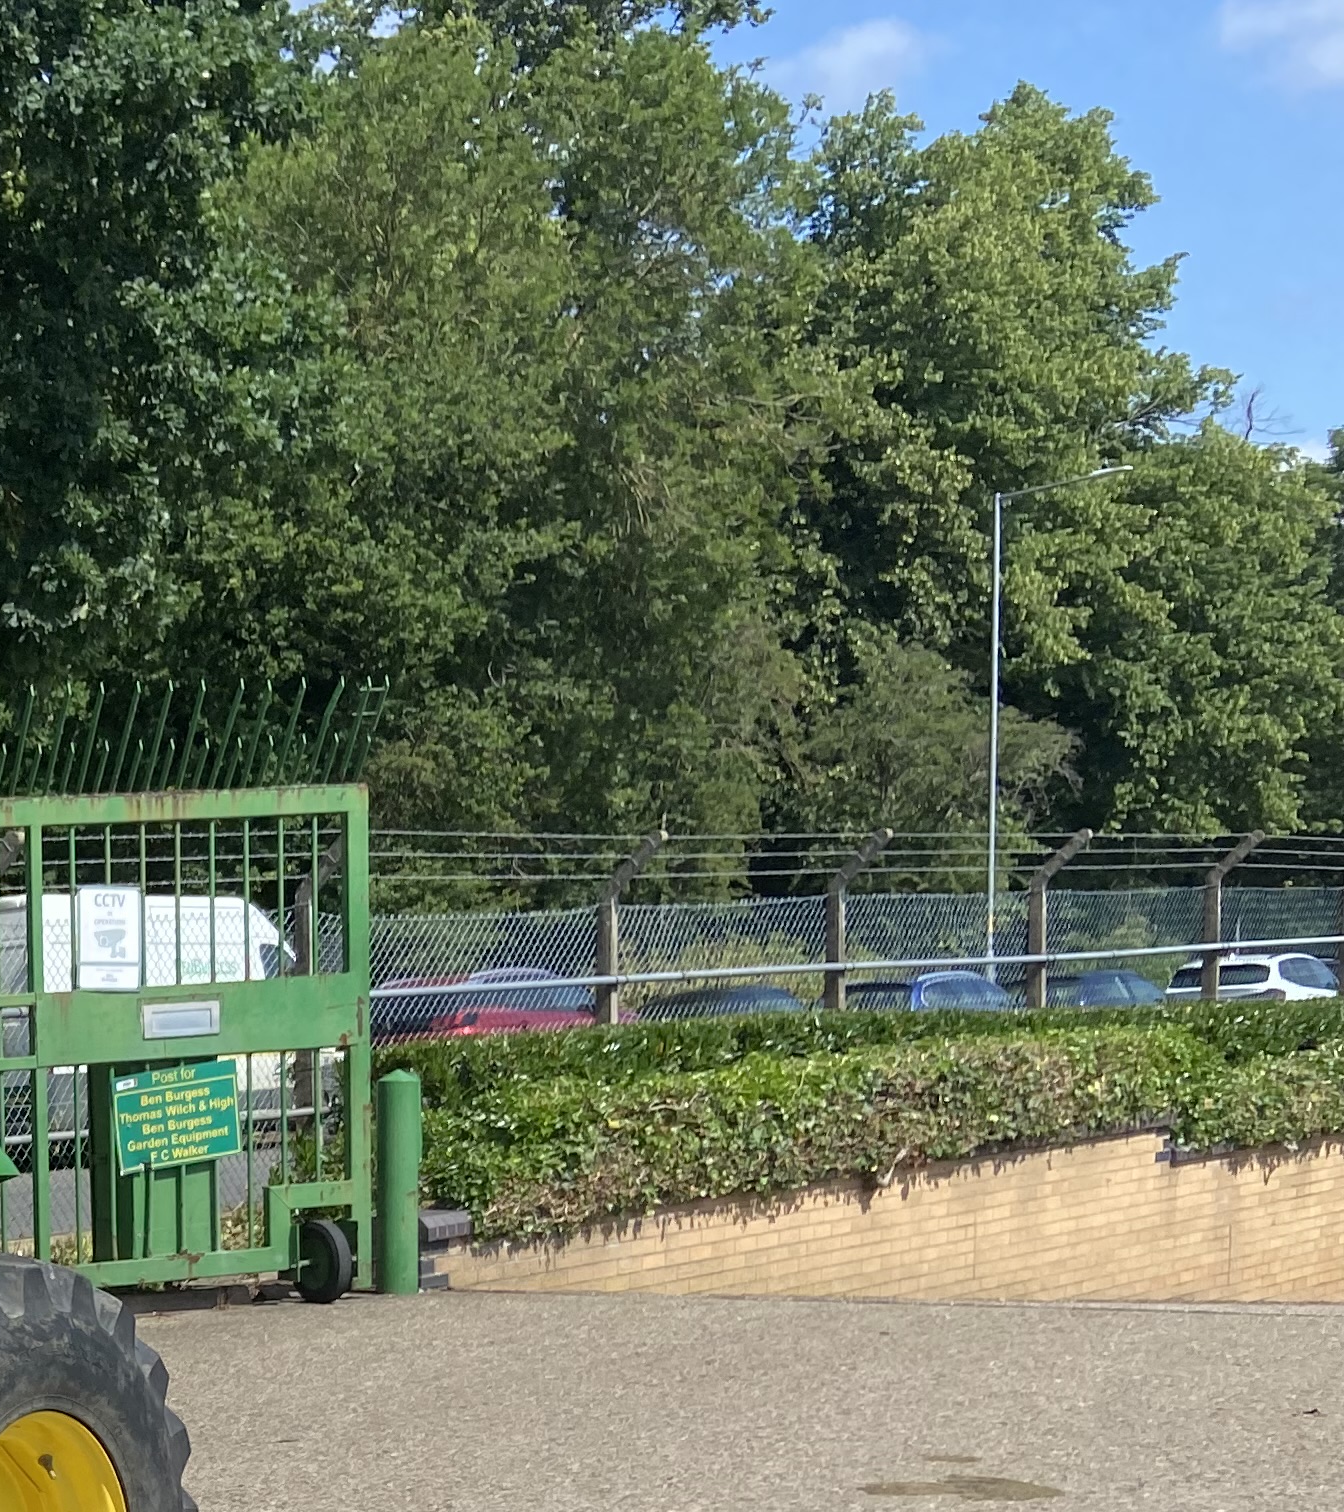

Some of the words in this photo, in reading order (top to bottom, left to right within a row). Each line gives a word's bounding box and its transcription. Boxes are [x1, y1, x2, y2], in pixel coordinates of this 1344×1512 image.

[94, 893, 126, 908] CCTV
[151, 1070, 178, 1085] Post
[180, 1067, 196, 1080] for
[140, 1094, 163, 1107] Ben
[165, 1087, 210, 1103] Burgess
[119, 1108, 163, 1125] Thomas
[165, 1103, 196, 1117] Wilch
[199, 1100, 206, 1112] &
[209, 1096, 234, 1111] High
[142, 1123, 165, 1135] Ben
[167, 1115, 212, 1131] Burgess
[127, 1137, 169, 1152] Garden
[171, 1125, 229, 1145] Equipment
[150, 1150, 158, 1162] F
[160, 1149, 169, 1161] C
[172, 1144, 209, 1159] Walker
